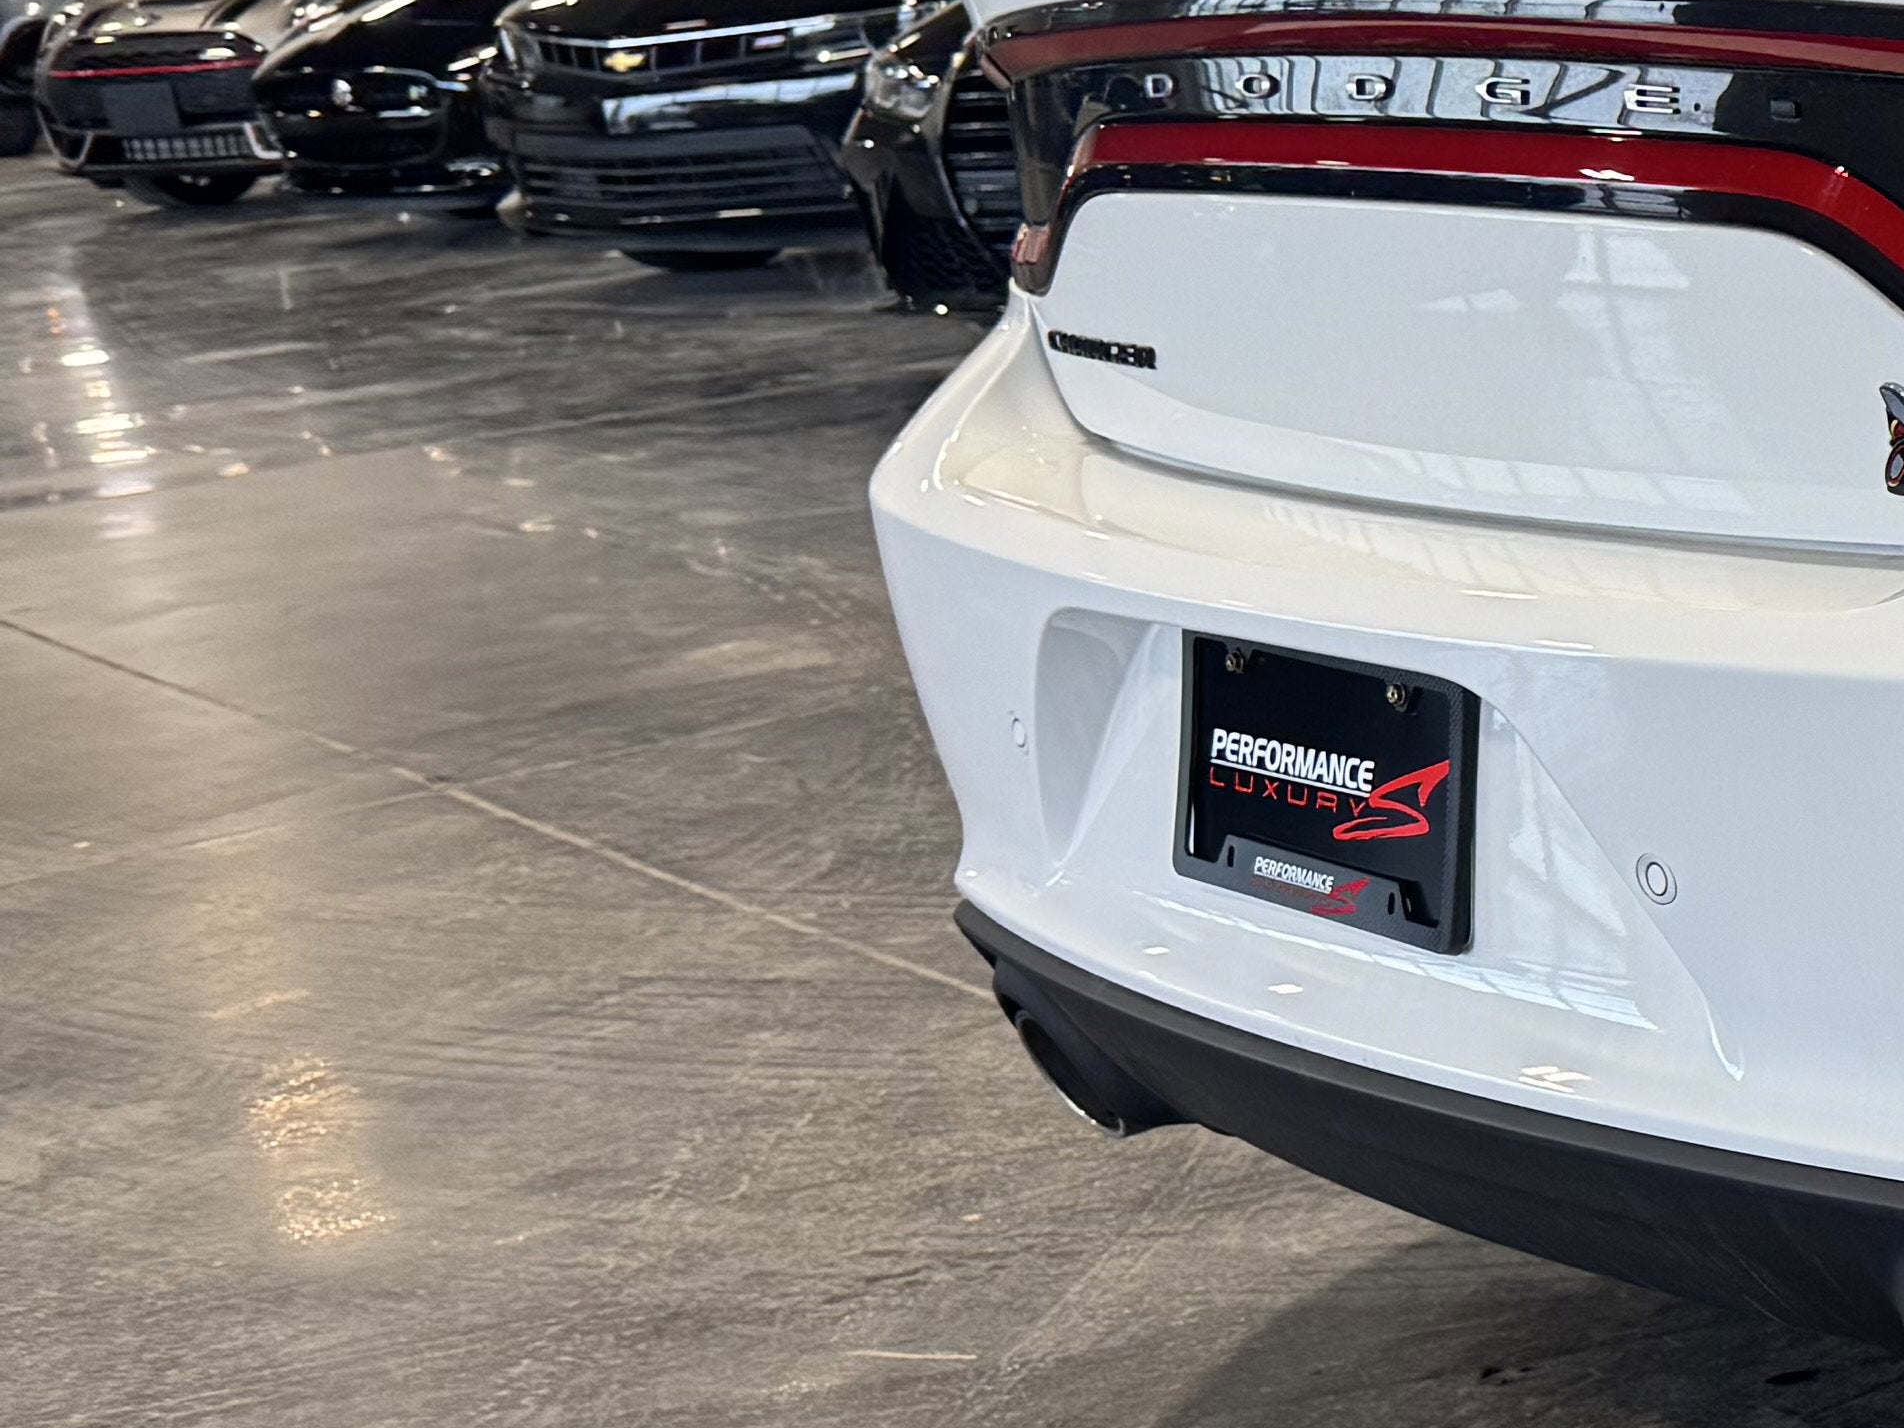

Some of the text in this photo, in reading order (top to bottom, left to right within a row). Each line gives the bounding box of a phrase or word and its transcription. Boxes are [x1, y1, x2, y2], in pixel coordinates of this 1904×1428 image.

[1143, 73, 1682, 114] DODGE
[1211, 728, 1376, 793] PERFORMANCE
[1253, 856, 1335, 893] PERFORMANCE
